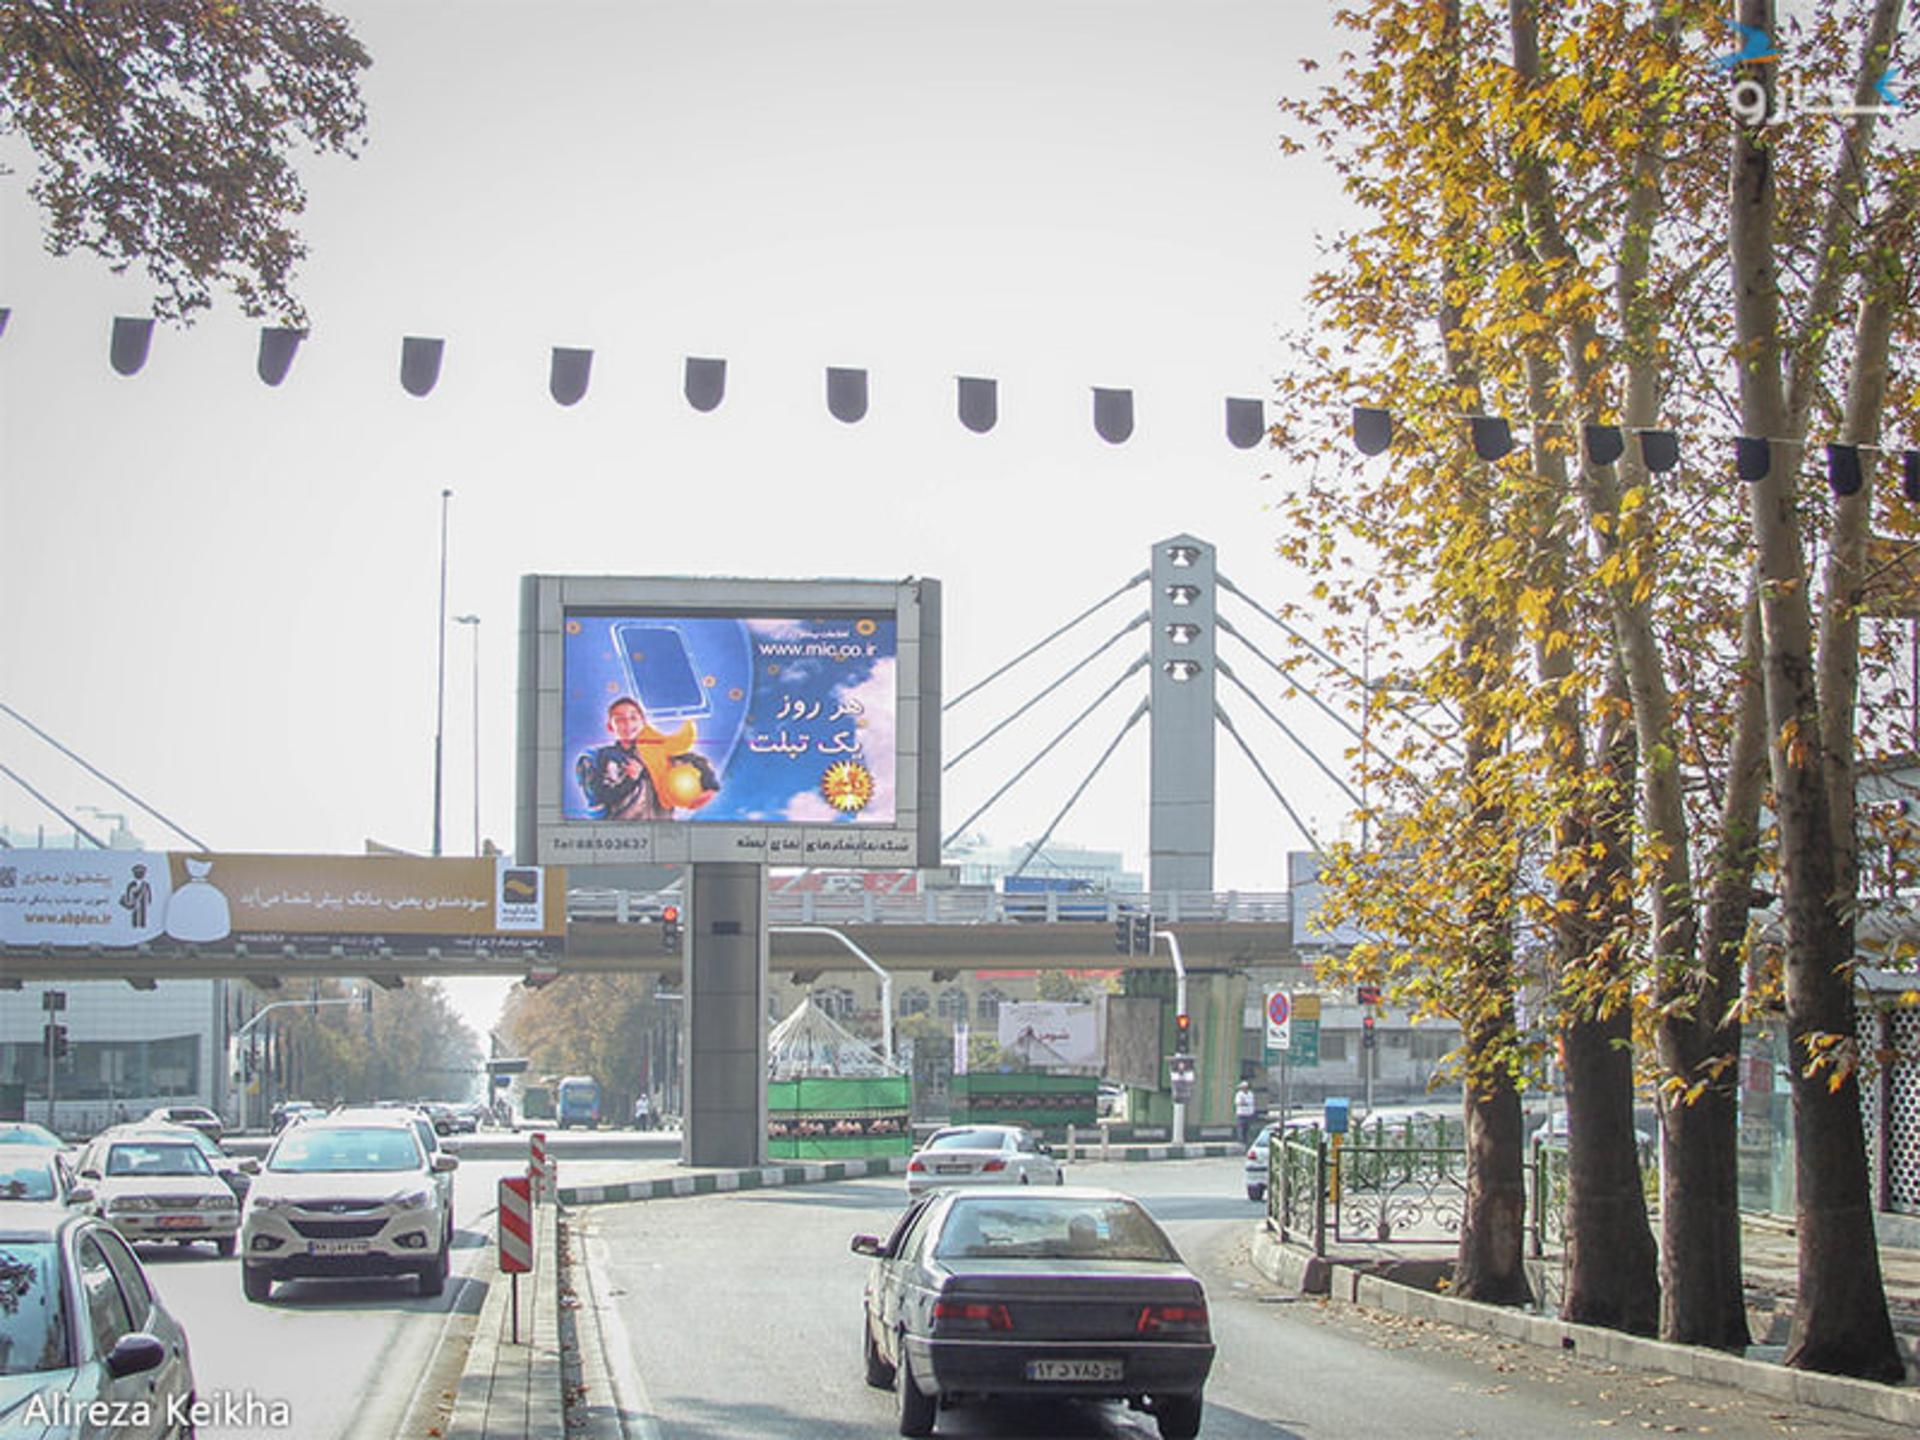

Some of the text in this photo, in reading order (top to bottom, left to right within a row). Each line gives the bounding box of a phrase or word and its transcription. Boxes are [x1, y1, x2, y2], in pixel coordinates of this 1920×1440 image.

[759, 642, 877, 657] www.mic.co.ir
[776, 695, 864, 721] هر روز
[748, 731, 863, 760] یک تبلت
